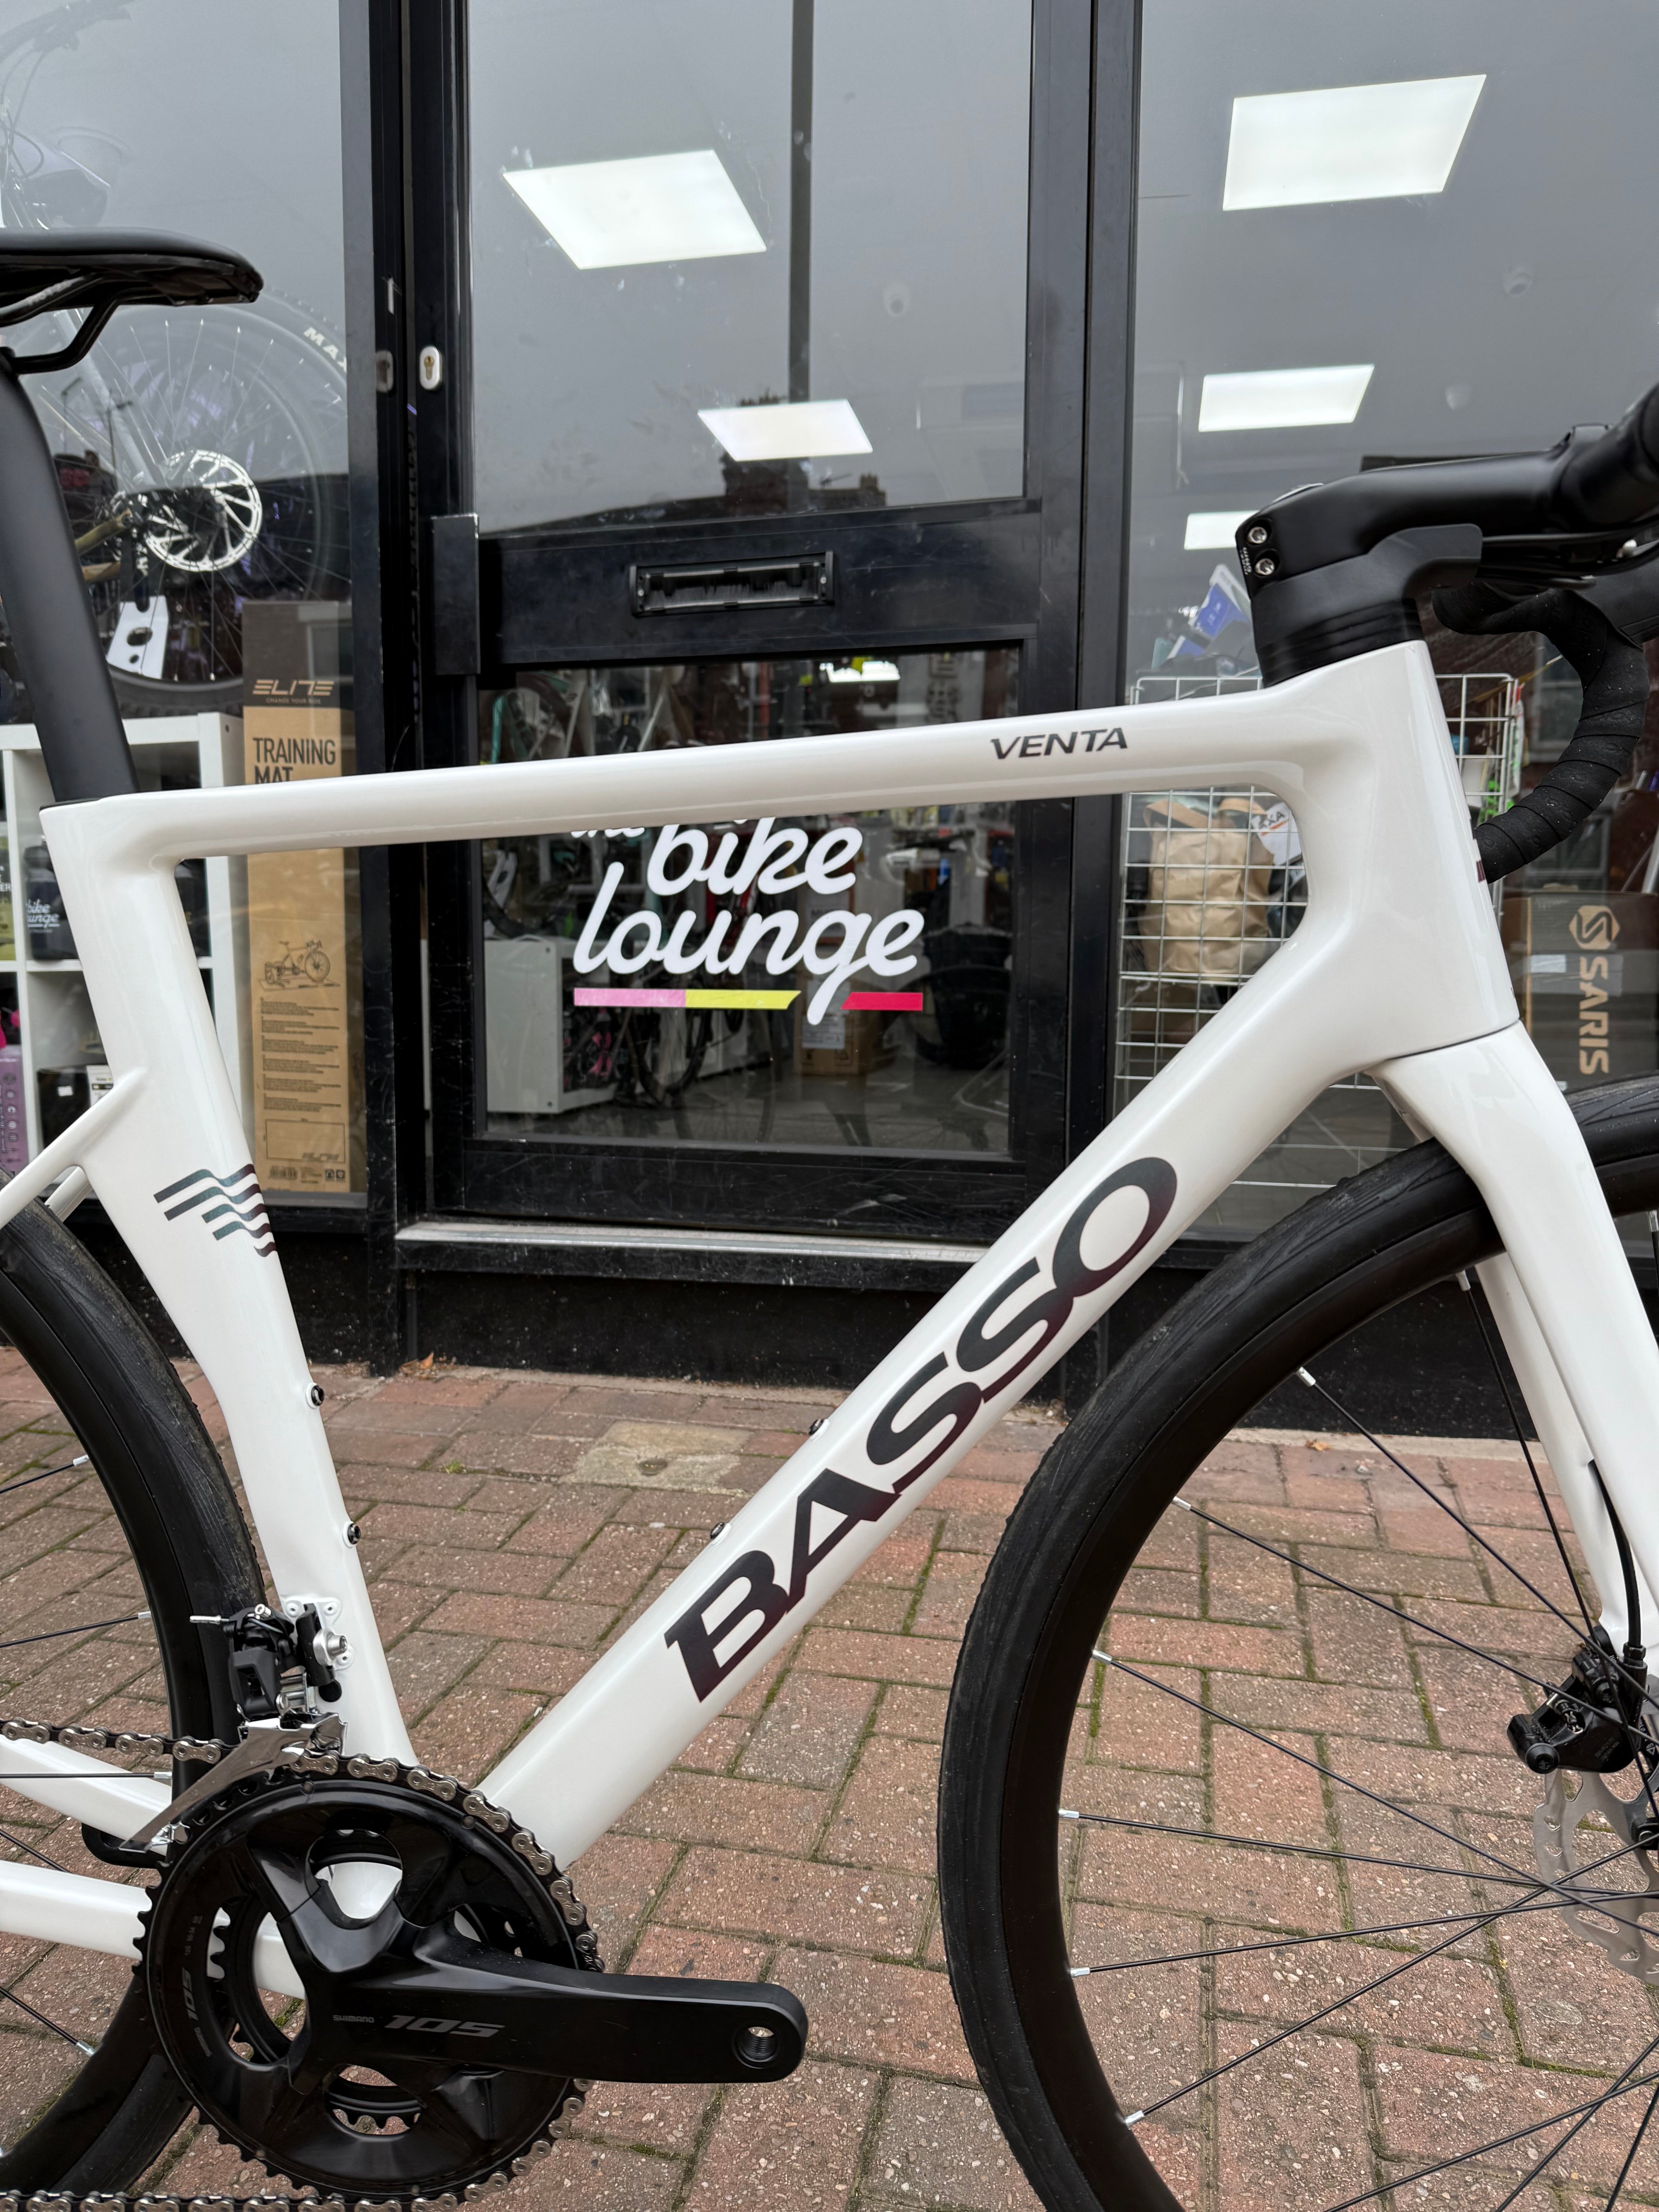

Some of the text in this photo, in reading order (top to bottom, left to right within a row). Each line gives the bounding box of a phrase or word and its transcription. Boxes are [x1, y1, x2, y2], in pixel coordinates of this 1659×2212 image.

[252, 680, 334, 696] ELITE
[253, 737, 336, 765] TRAINING
[991, 728, 1128, 759] VENTA
[254, 765, 294, 785] MAT
[647, 817, 863, 895] bike
[573, 862, 924, 1025] lounge
[1579, 956, 1609, 1075] SARIS
[664, 1157, 1178, 1703] BASSO
[182, 1967, 198, 2020] 105
[333, 2014, 505, 2037] SHIMANO 105
